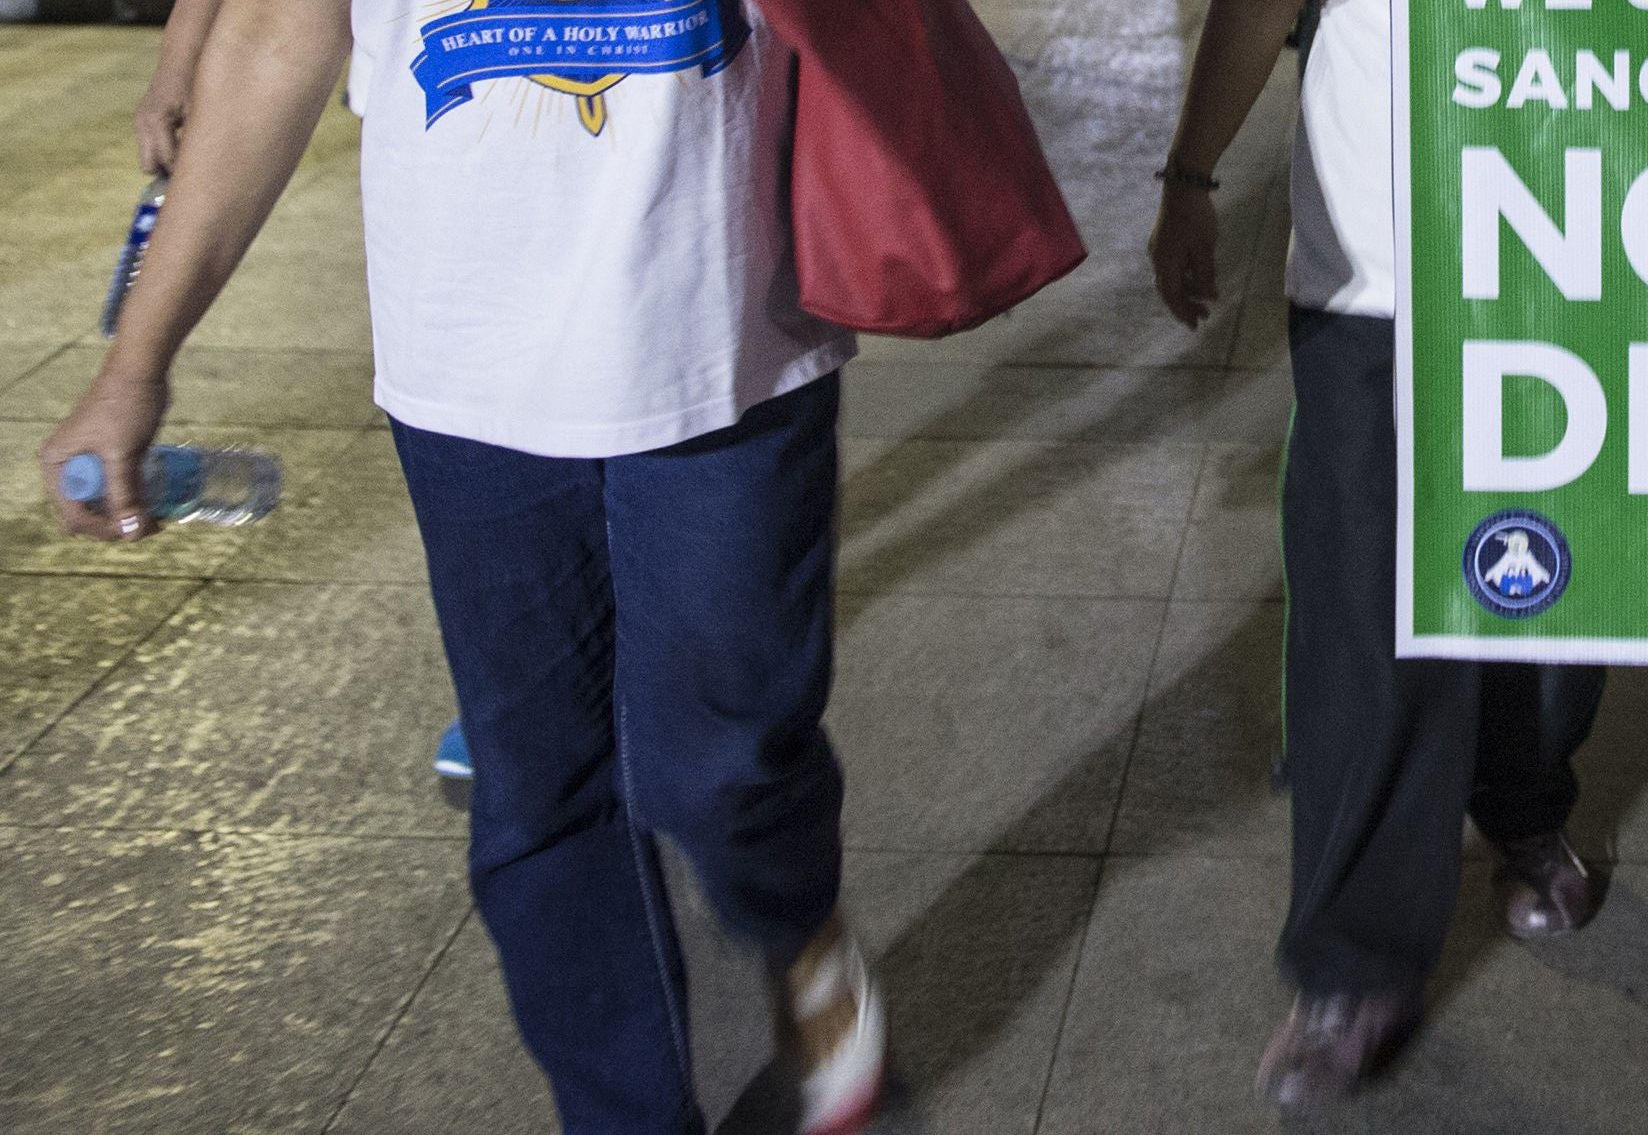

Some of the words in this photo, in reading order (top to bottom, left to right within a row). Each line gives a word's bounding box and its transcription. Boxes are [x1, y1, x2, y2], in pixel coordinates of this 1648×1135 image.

[441, 27, 506, 52] HEART
[508, 27, 538, 43] OF
[541, 27, 558, 42] A
[563, 26, 620, 42] HOLY
[623, 10, 709, 41] WARRIOR
